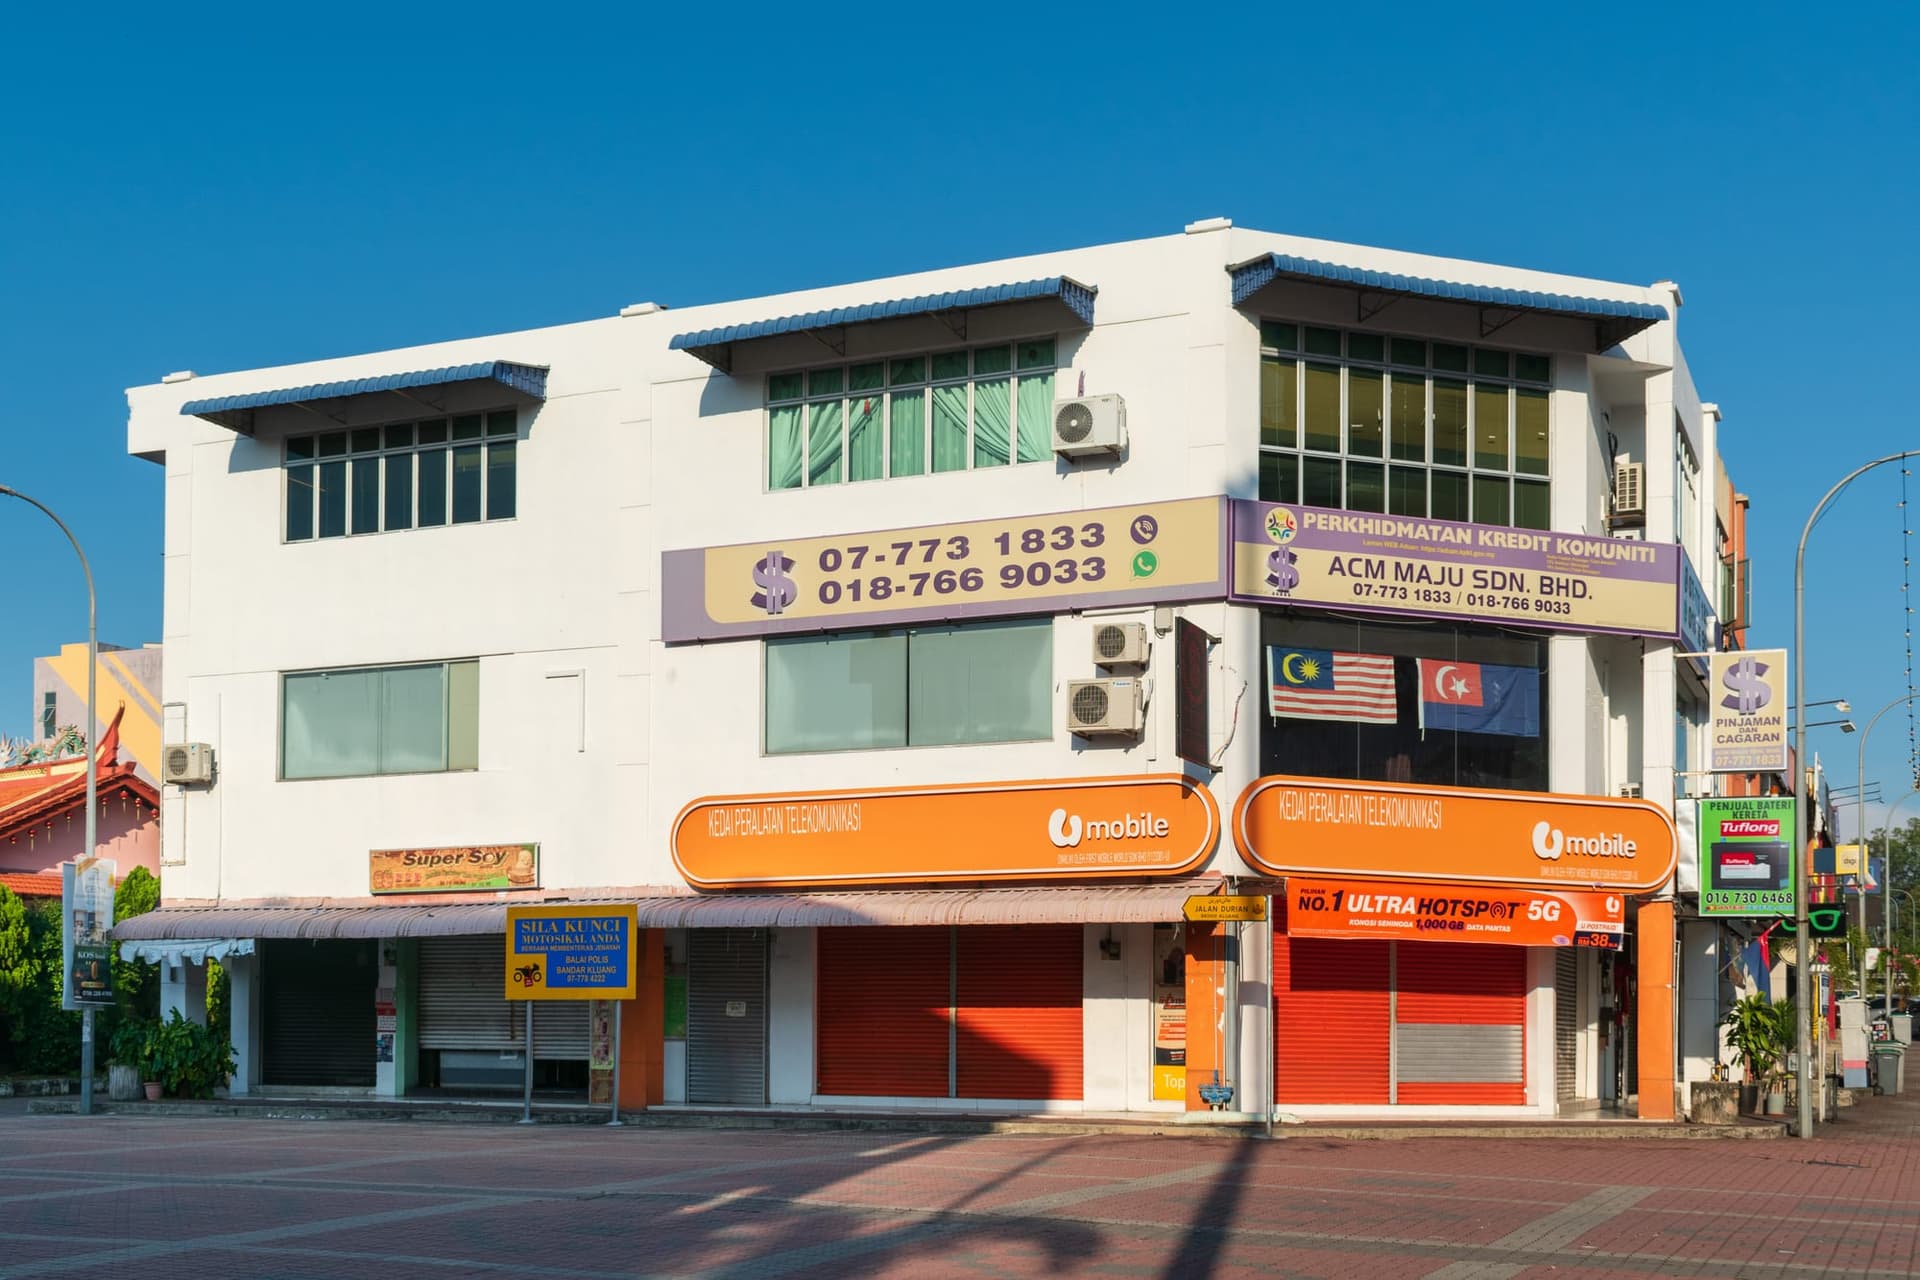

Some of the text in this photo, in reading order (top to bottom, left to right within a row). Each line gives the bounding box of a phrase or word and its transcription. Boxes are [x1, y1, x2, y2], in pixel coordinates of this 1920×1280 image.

[1303, 512, 1656, 563] PERKHIDMATAN KREDIT KOMUNITI
[819, 522, 1106, 573] 07-773 1833
[819, 556, 1107, 604] 018-766 9033
[1328, 556, 1593, 599] ACM MAJU SDN. BHD.
[1414, 588, 1451, 604] 1833
[1534, 600, 1571, 614] 9033
[1716, 716, 1781, 728] PINJAMAN
[1716, 733, 1780, 744] CAGARAN
[1279, 790, 1442, 829] KEDAI PERALATAN TELEKOMUNIKASI
[1710, 800, 1791, 811] PENJUAL BATERI
[708, 802, 862, 837] KEDAI PERALATAN TELEKOMUNIKASI
[1732, 810, 1769, 819] KERETA
[1087, 812, 1169, 840] mobile
[1721, 822, 1779, 834] Tuflong
[1566, 832, 1637, 858] mobile
[403, 851, 465, 867] Super
[468, 850, 508, 866] Soy
[1706, 892, 1793, 903] 016 730 6468
[1527, 900, 1561, 921] 5G
[521, 919, 620, 933] SILA KUNCI
[1416, 918, 1447, 931] 1,000
[1448, 921, 1464, 931] GB
[522, 934, 620, 944] MOTOSIKAL ANDA
[565, 955, 609, 964] BALAI POLIS
[556, 966, 617, 974] BANDAR KLUANG
[1163, 1073, 1186, 1091] Top
